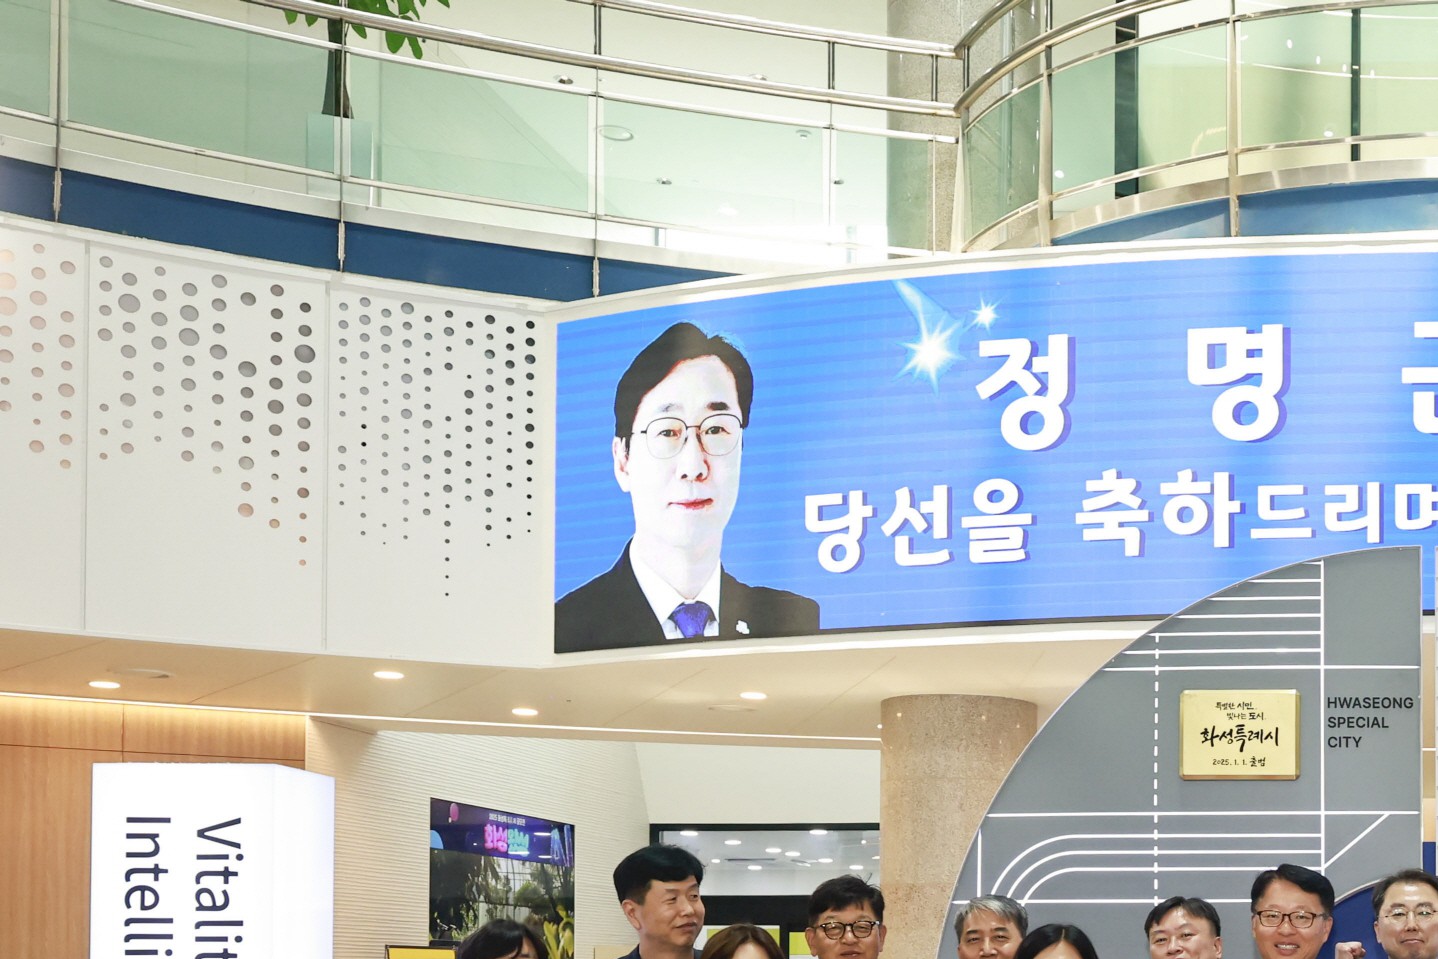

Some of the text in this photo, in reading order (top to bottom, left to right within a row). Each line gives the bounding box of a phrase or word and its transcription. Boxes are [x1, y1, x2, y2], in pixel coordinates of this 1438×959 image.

[805, 478, 1032, 573] 당선을
[1327, 696, 1414, 710] HWASEONG
[1327, 716, 1390, 729] SPECIAL
[1200, 723, 1279, 753] 화성특례시
[1327, 736, 1363, 749] CITY
